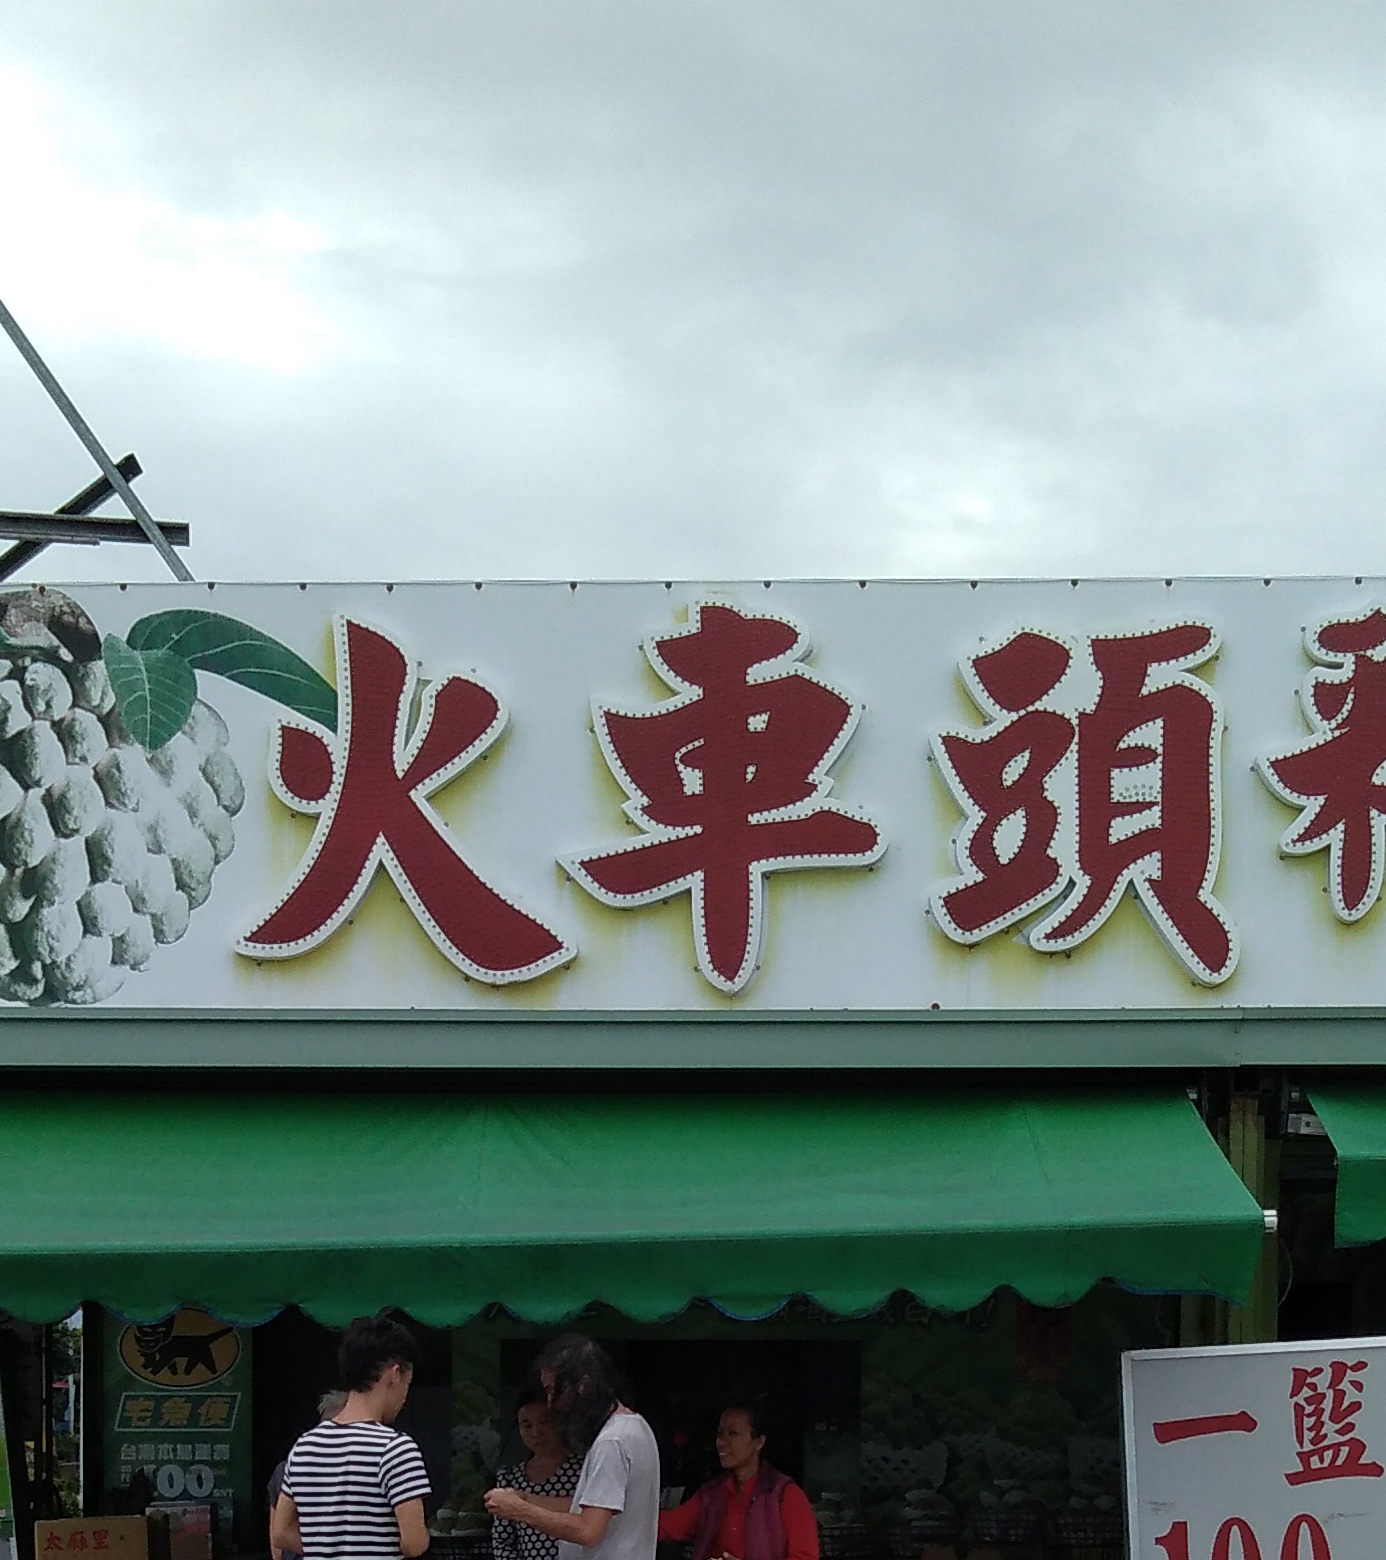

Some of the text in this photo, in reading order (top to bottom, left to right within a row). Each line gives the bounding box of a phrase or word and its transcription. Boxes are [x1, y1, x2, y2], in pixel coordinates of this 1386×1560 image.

[122, 1397, 231, 1428] 宅急便
[1153, 1359, 1385, 1487] 一籃
[135, 1463, 215, 1499] 00
[44, 1528, 110, 1551] 太麻里
